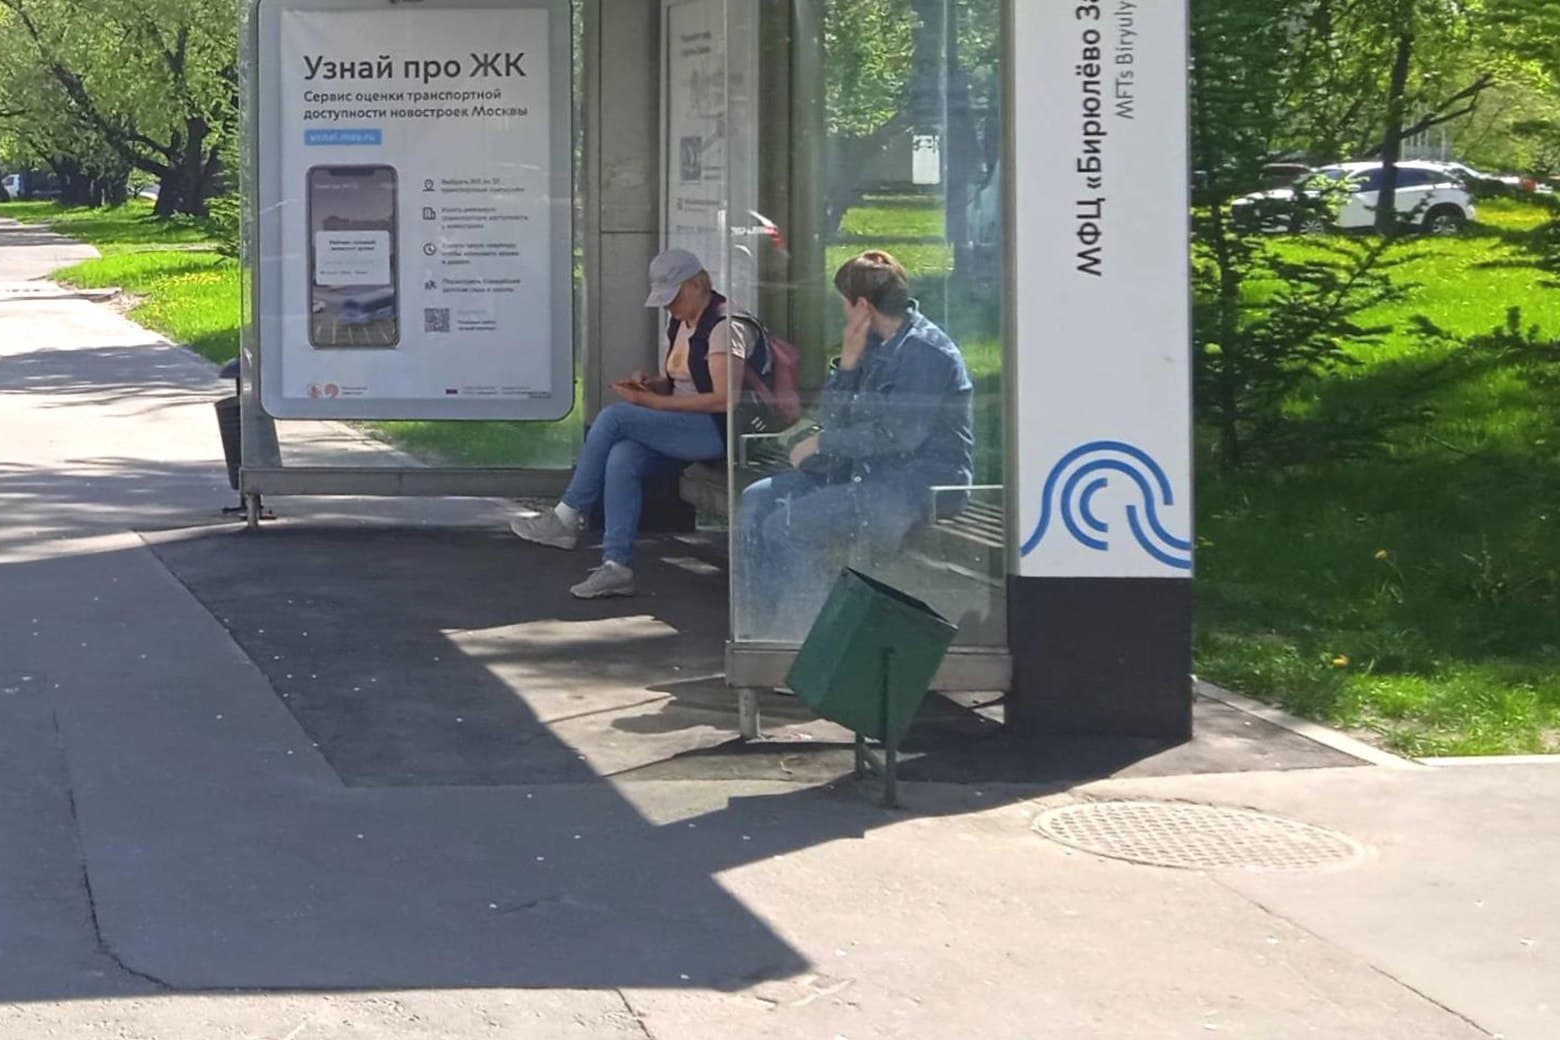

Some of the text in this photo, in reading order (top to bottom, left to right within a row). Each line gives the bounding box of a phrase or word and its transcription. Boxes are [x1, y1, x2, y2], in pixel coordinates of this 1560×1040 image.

[304, 52, 527, 84] Узнай про ЖК
[303, 106, 528, 122] доступности новостроек Москвы
[304, 88, 502, 104] Сервис оценки транспортной
[1076, 28, 1108, 191] «Бирюлёво
[1116, 69, 1135, 120] MFTs
[1077, 197, 1106, 276] МФЦ
